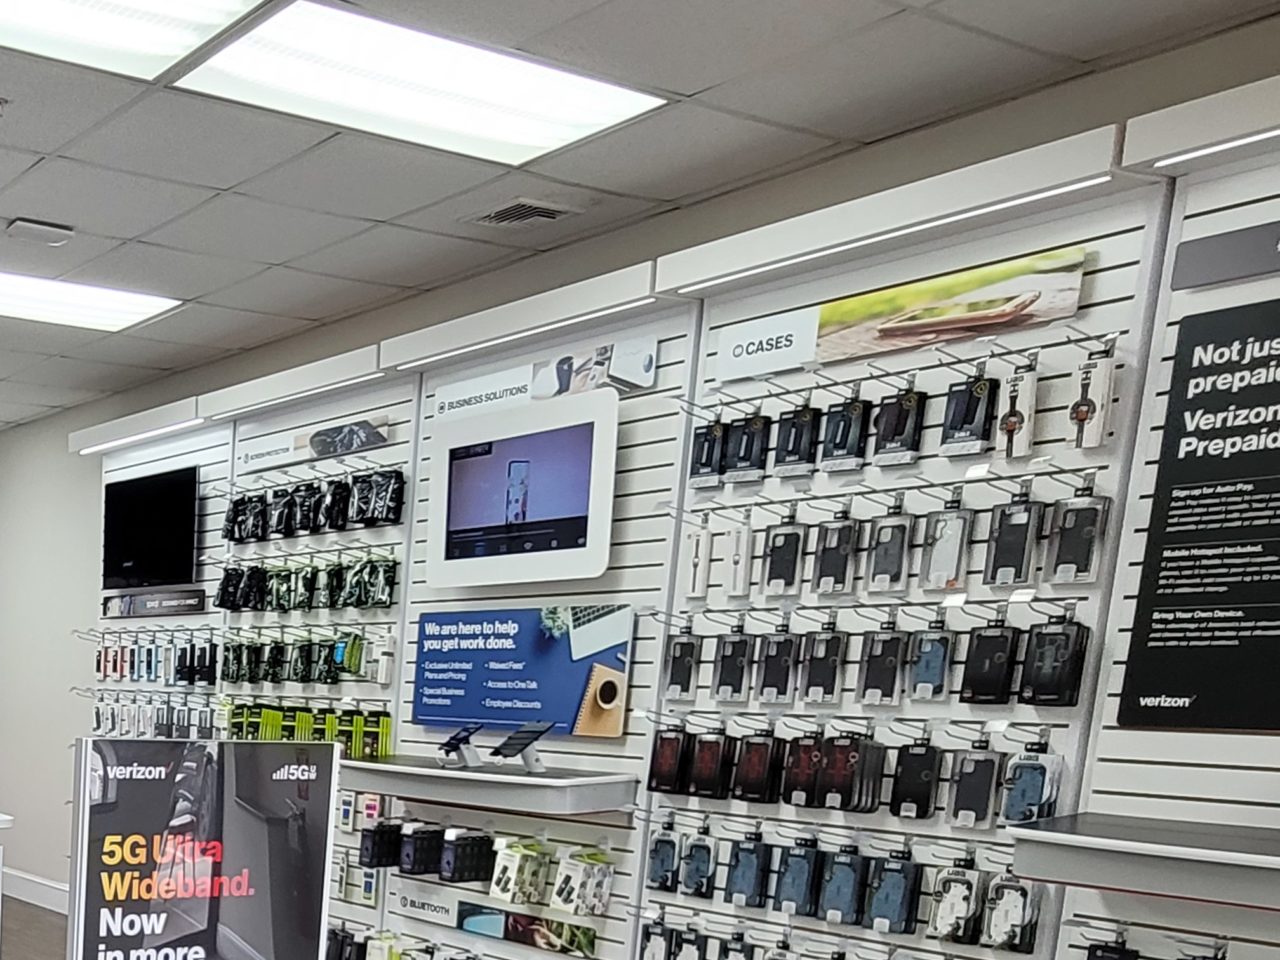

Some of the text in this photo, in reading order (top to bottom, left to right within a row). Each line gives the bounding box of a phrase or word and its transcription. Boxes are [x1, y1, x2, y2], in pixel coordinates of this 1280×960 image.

[746, 334, 793, 355] CASES
[1191, 336, 1280, 368] Not jus
[448, 384, 528, 411] BUSINESS SOLUTIONS
[1183, 404, 1280, 432] Verizon
[1177, 427, 1280, 459] Prepaid
[424, 620, 518, 636] We are here to help
[423, 636, 516, 652] you get work done.
[1139, 694, 1190, 708] verizon
[107, 762, 166, 780] verizon
[101, 834, 224, 865] 5G Ultra
[101, 868, 255, 900] Wideband.
[410, 899, 449, 916] BLUETOOTH
[99, 907, 167, 937] Now
